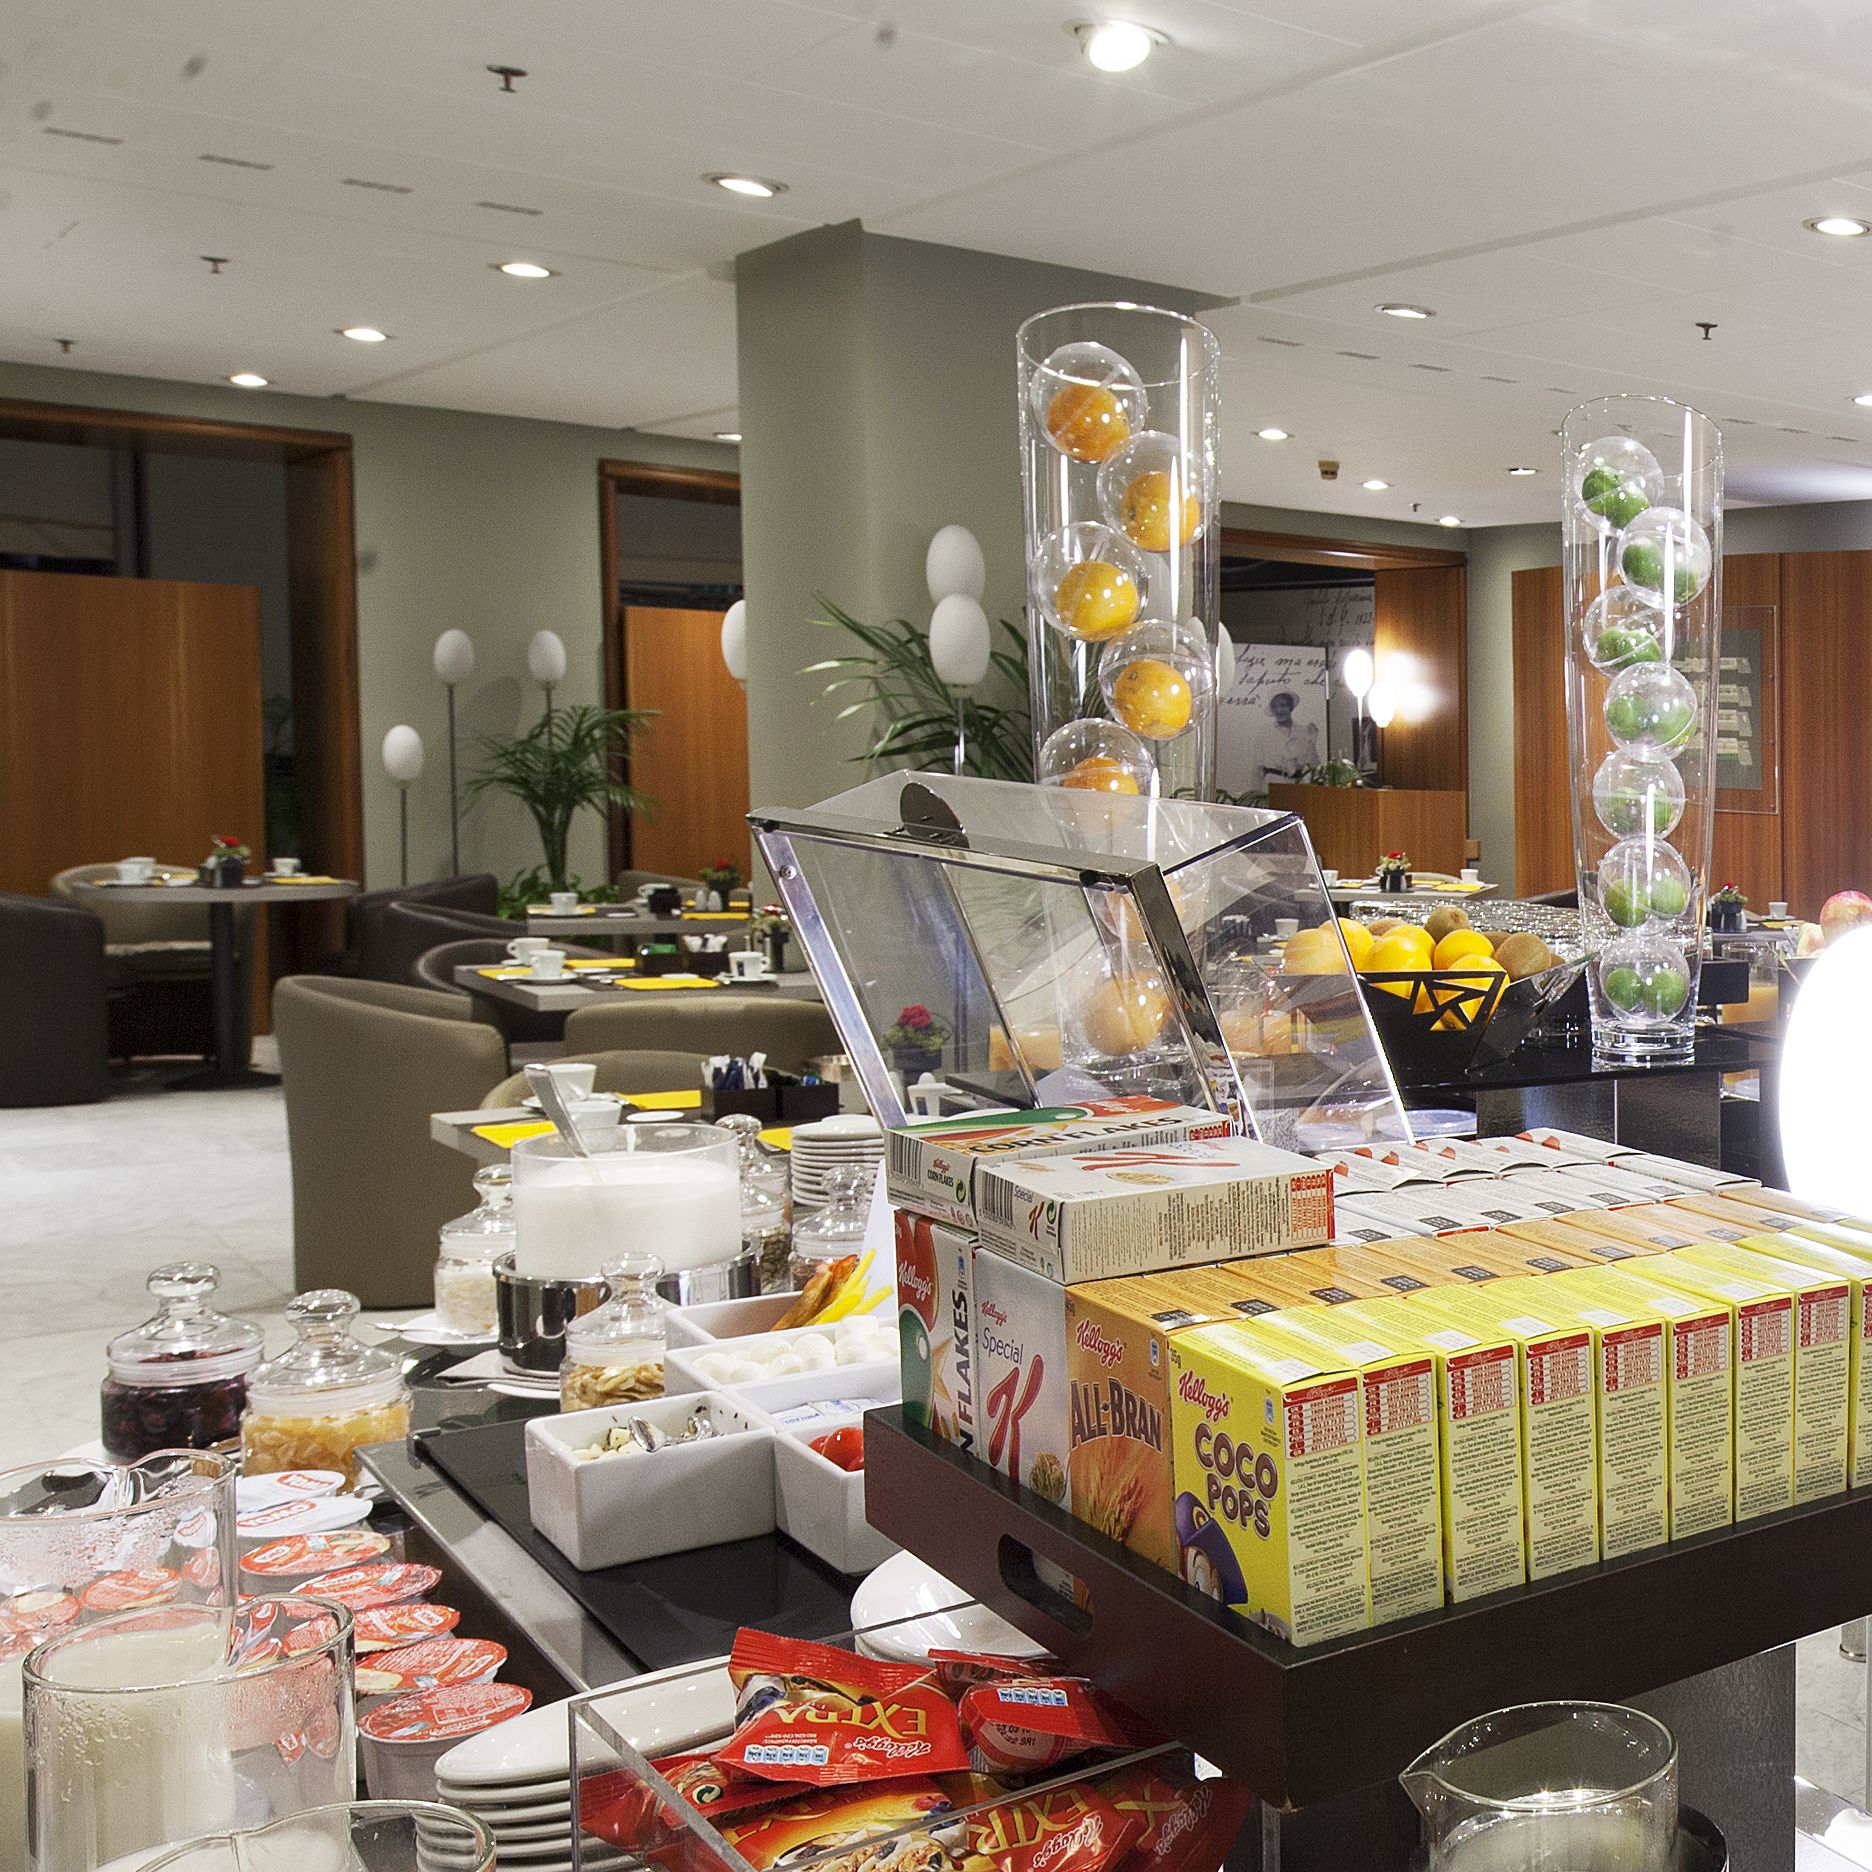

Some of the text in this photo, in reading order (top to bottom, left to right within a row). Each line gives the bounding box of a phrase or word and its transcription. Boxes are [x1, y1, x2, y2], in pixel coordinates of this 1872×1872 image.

[970, 1115, 1183, 1157] CORN FLAKES
[898, 1260, 932, 1300] Kellogg's
[981, 1301, 1008, 1325] Kellogg's
[951, 1289, 973, 1425] FLAKES
[982, 1327, 1024, 1365] Special
[1076, 1319, 1127, 1368] Kellogg's
[986, 1354, 1044, 1485] K
[1070, 1376, 1164, 1453] ALL-BRAN
[1178, 1370, 1232, 1422] Kellogg's
[1194, 1422, 1279, 1500] COCO
[1206, 1473, 1272, 1540] POPS
[852, 1735, 932, 1758] Kellogg's
[1032, 1813, 1104, 1869] Kellogg's
[1155, 1784, 1214, 1857] Kellogg's
